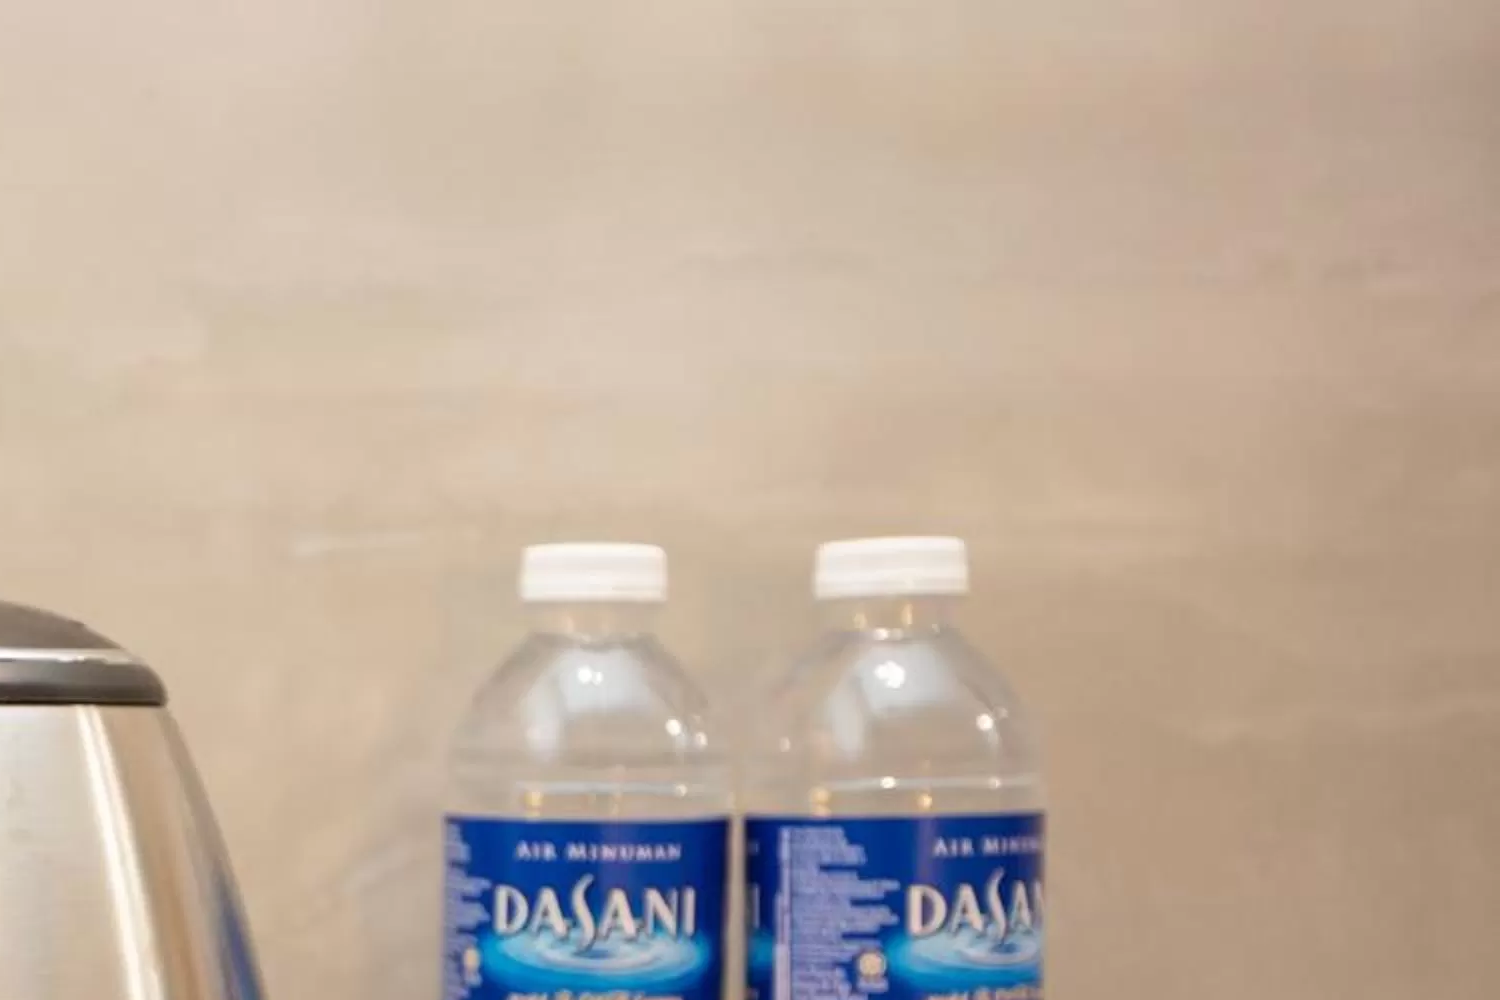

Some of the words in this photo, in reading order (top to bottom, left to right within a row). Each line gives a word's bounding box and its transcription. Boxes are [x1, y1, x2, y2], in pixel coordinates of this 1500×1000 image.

[515, 840, 556, 862] AIR
[567, 842, 682, 862] MINUMAN
[933, 837, 974, 857] AIR
[493, 873, 696, 951] DASANI
